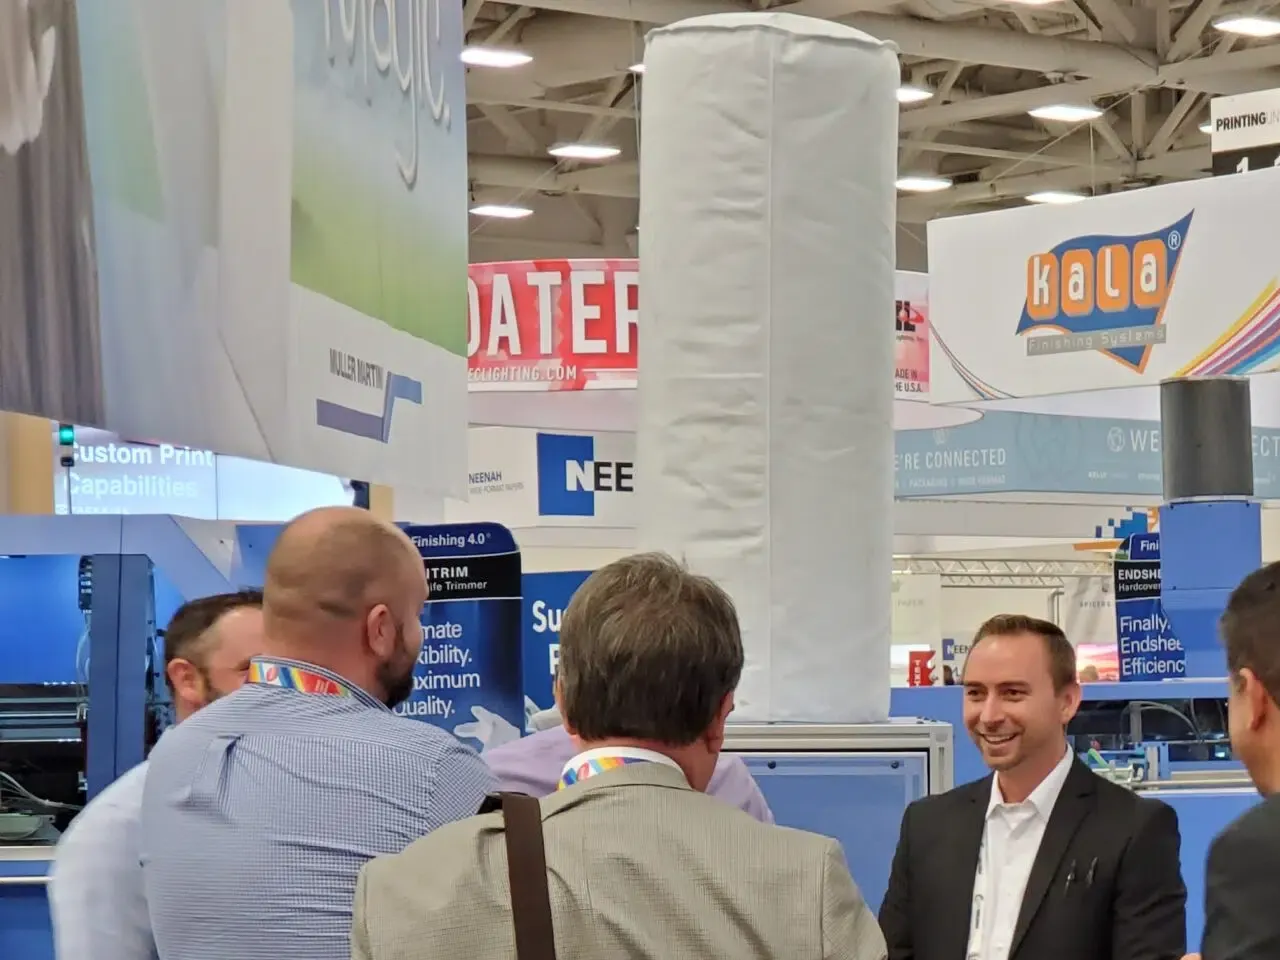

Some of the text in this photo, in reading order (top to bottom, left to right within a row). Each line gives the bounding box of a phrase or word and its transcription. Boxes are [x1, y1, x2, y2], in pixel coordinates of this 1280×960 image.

[159, 443, 214, 468] Print
[925, 447, 1006, 469] CONNECTED
[63, 471, 201, 499] Capabilities
[468, 470, 503, 485] NEENAH
[566, 460, 634, 492] NEE
[412, 534, 465, 548] Finishing
[446, 581, 488, 591] Trimmer
[1120, 614, 1172, 634] Finally.
